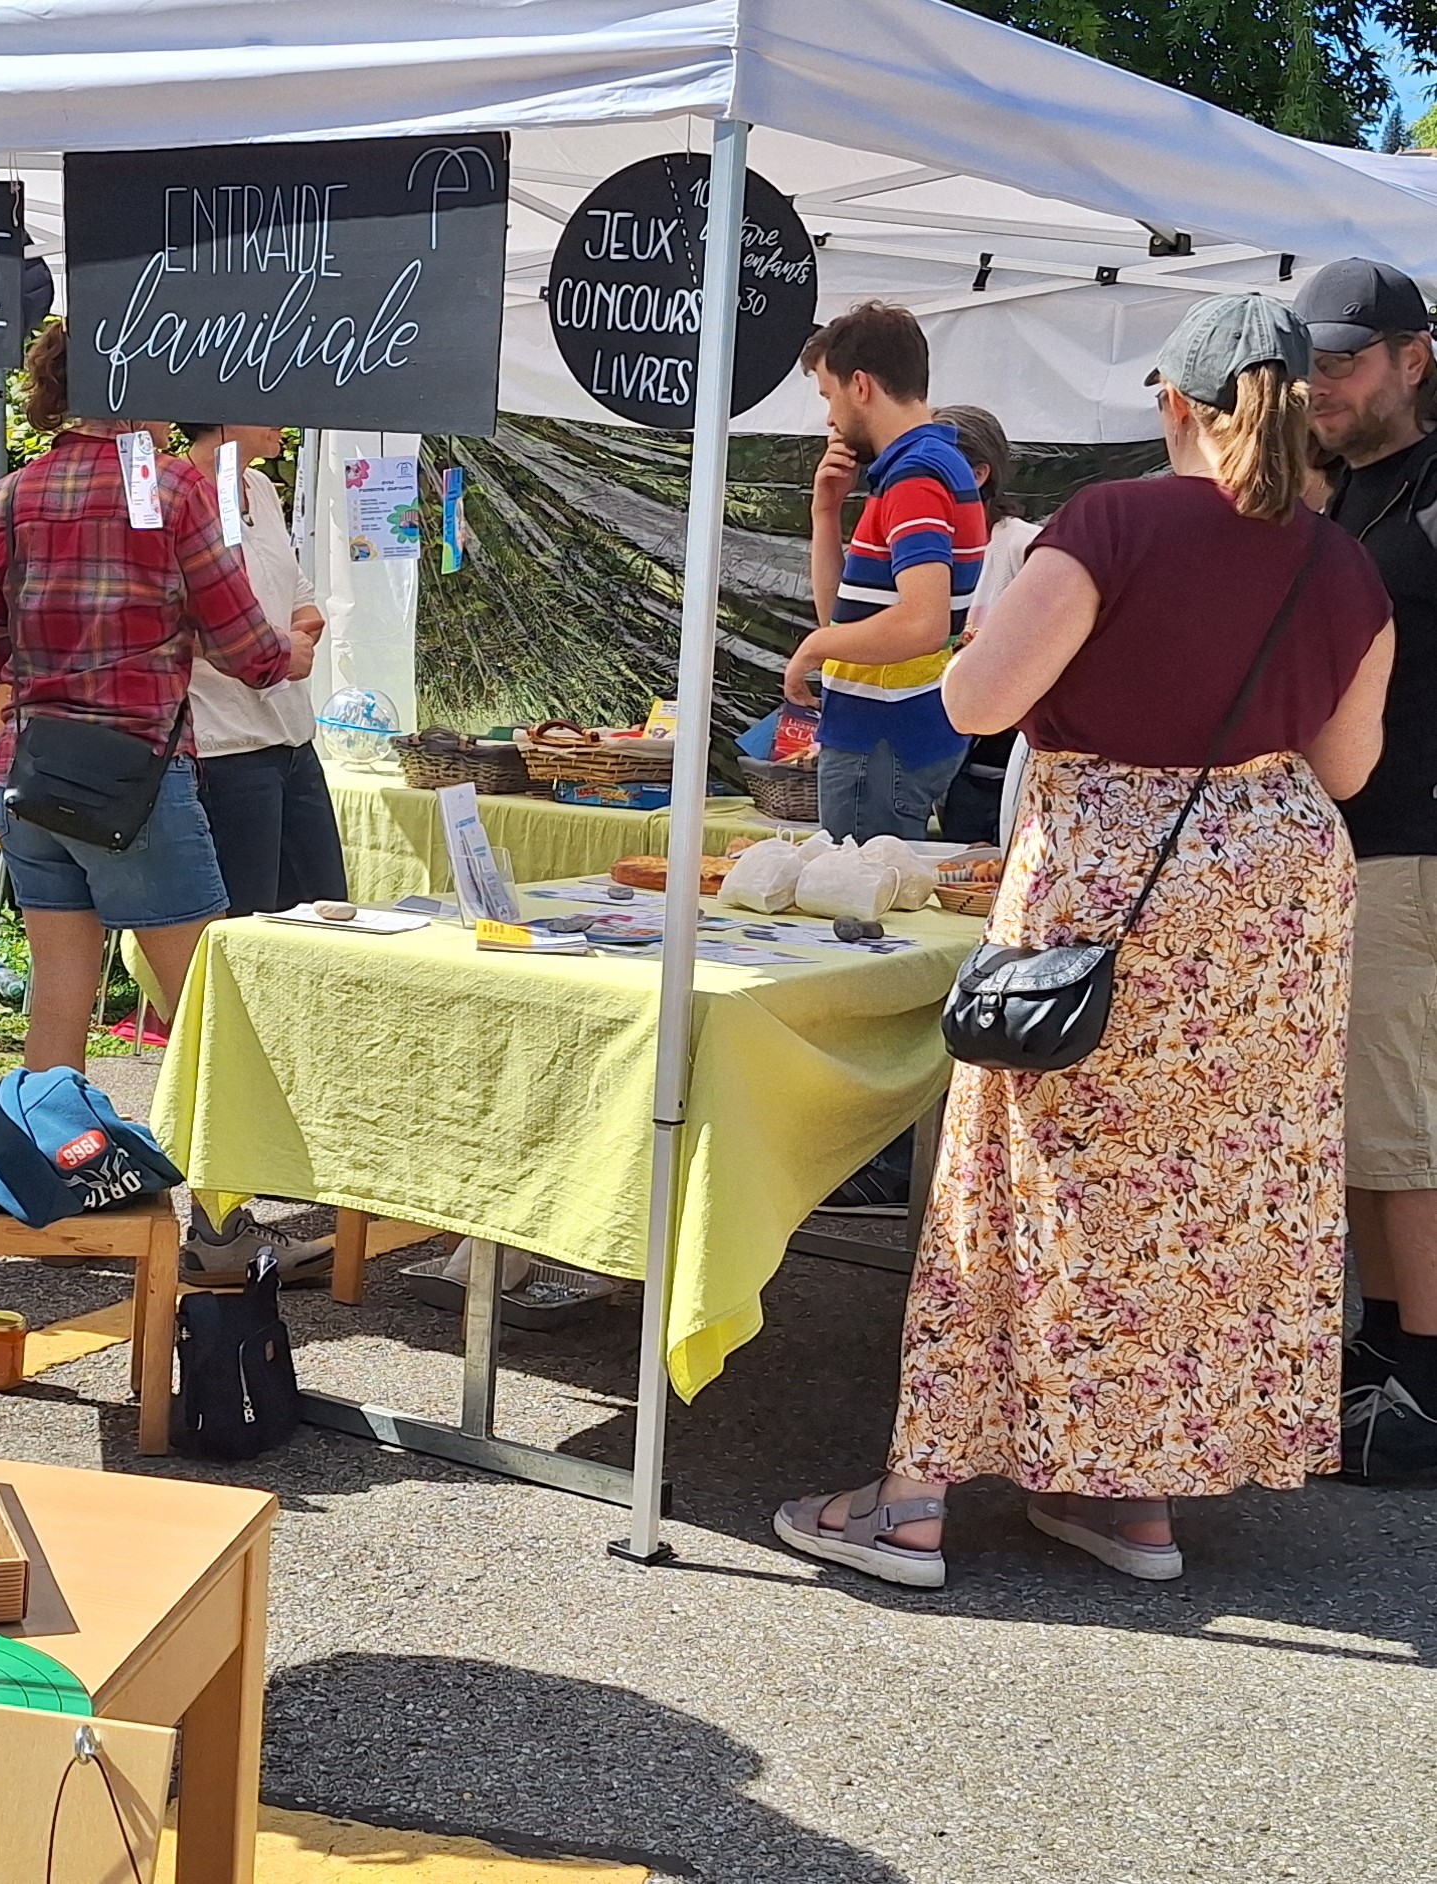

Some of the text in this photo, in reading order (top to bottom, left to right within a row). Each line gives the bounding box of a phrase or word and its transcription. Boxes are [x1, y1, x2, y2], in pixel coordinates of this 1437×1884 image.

[164, 183, 349, 278] ENTRAIDE
[584, 210, 679, 264] JEUX
[743, 246, 814, 285] enfants
[95, 252, 422, 413] familiale
[556, 278, 703, 334] CONCOURS
[591, 349, 693, 406] LIVRES
[785, 726, 815, 743] CLA
[62, 1135, 101, 1166] 1966
